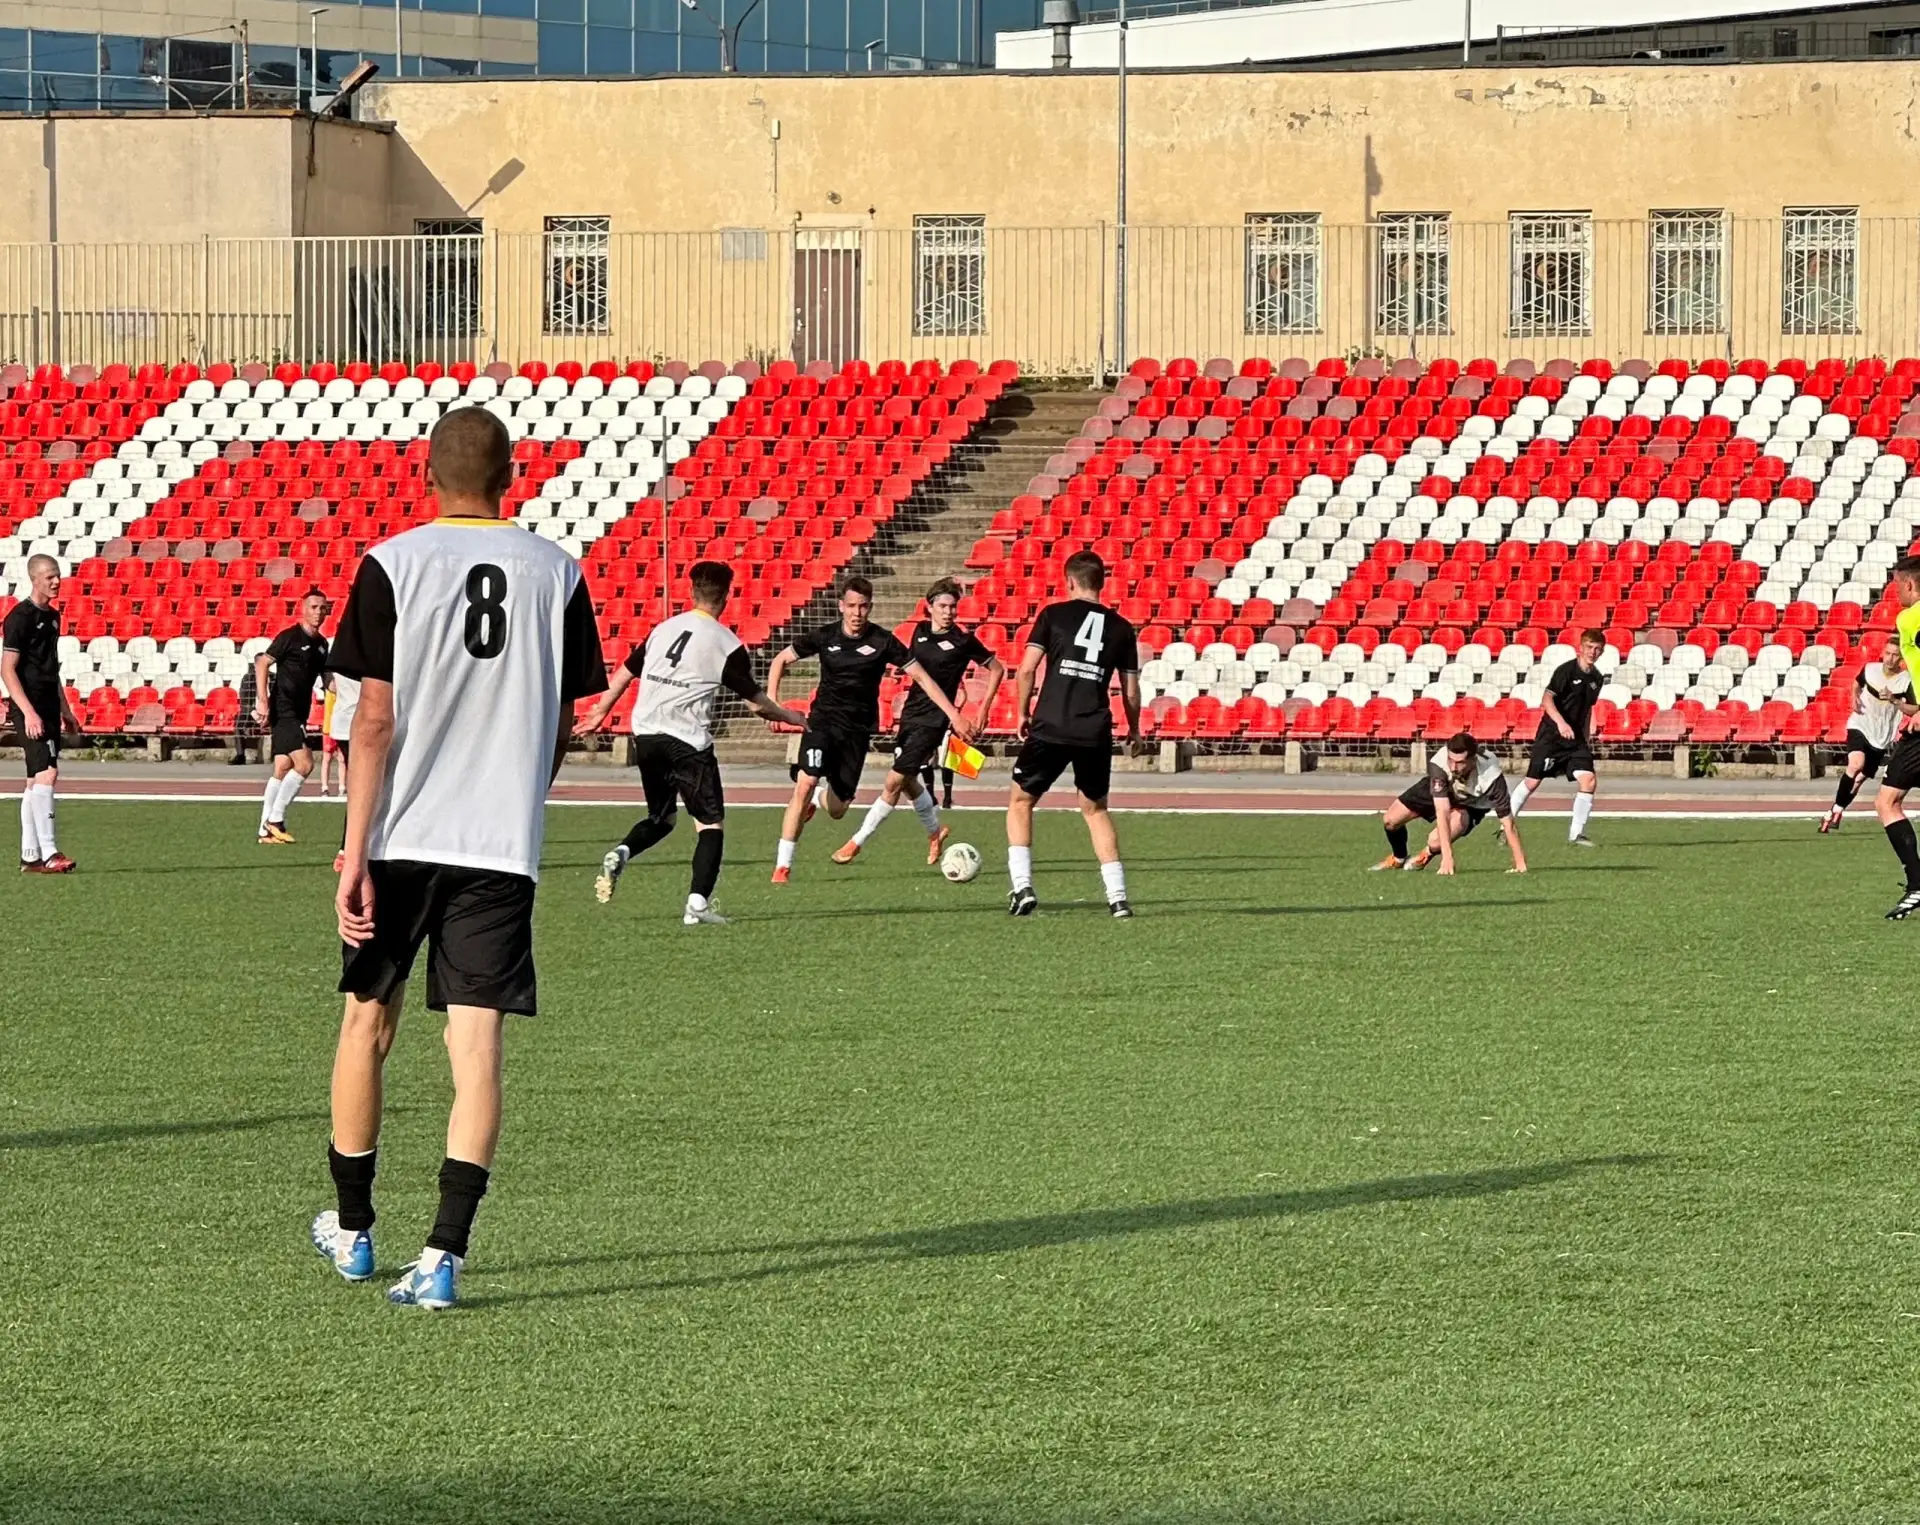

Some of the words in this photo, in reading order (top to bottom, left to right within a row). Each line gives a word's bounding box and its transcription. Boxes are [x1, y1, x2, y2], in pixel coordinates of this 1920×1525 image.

[464, 564, 508, 660] 8
[665, 630, 693, 668] 4
[1074, 610, 1105, 662] 4
[806, 748, 823, 768] 18
